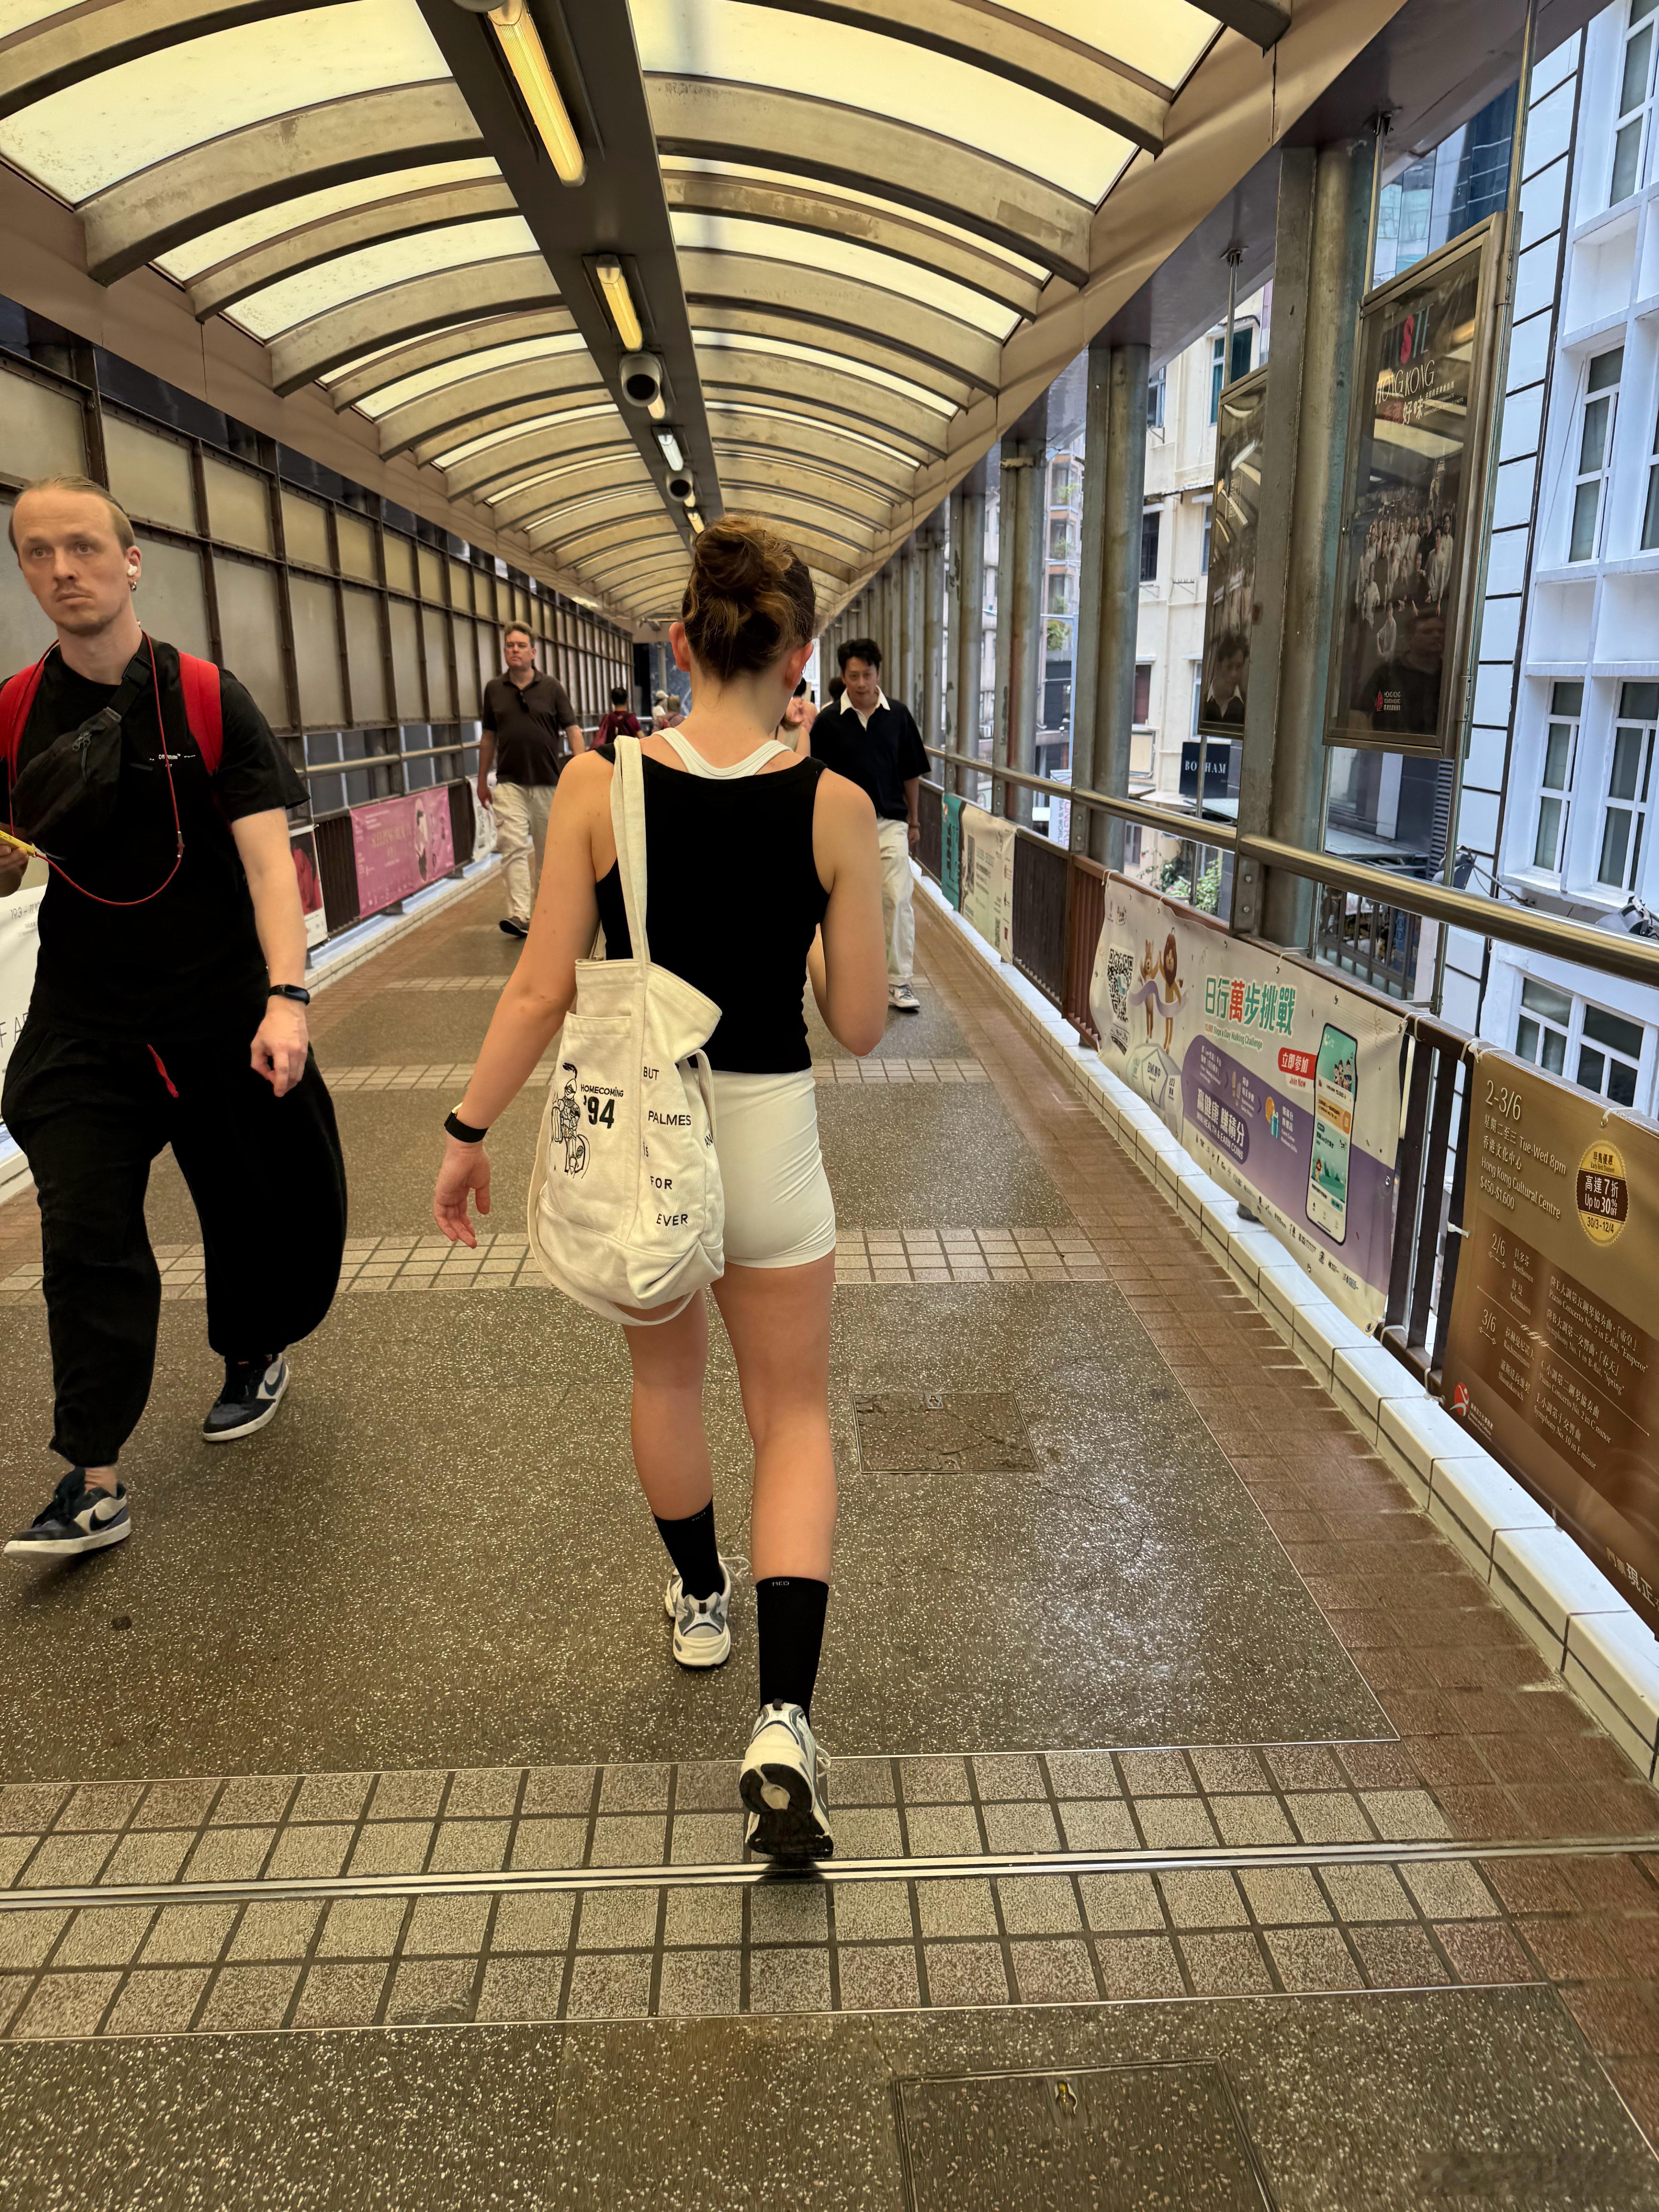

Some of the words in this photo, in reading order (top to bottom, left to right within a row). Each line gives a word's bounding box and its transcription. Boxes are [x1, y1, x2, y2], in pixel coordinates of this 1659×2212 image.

[1375, 369, 1403, 405] HONG
[1405, 360, 1434, 397] KONG
[1185, 760, 1226, 774] BOHAM
[1205, 977, 1296, 1036] 日行萬步挑戰
[1213, 1026, 1221, 1037] Steps
[1231, 1032, 1245, 1045] Walking
[1245, 1035, 1262, 1050] Challenge
[643, 1066, 659, 1080] BUT
[1281, 1052, 1309, 1073] 立即參加
[1297, 1078, 1306, 1088] Now
[1486, 1080, 1522, 1120] 2-3/6
[648, 1110, 691, 1126] PALMES
[1203, 1117, 1218, 1136] HEALTH
[1220, 1132, 1231, 1149] EARN
[1231, 1142, 1243, 1159] COINS
[1484, 1113, 1516, 1144] 星期二至三
[1520, 1135, 1549, 1164] Tue-Wed
[1550, 1154, 1566, 1175] 8pm
[1483, 1135, 1522, 1170] 香港文化中心
[650, 1176, 672, 1190] FOR
[1481, 1155, 1496, 1178] Hong
[1497, 1166, 1511, 1189] Kong
[1513, 1176, 1537, 1204] Cultural
[1539, 1194, 1561, 1219] Centre
[1585, 1193, 1593, 1210] Up
[1594, 1197, 1600, 1209] to
[656, 1213, 688, 1226] EVER
[1492, 1233, 1505, 1256] 2/6
[1482, 1309, 1496, 1332] 3/6
[1549, 1289, 1562, 1306] Piano
[1563, 1301, 1583, 1323] Concerto
[1585, 1317, 1593, 1331] No.
[1594, 1325, 1598, 1334] 5
[1599, 1330, 1604, 1340] in
[1569, 1341, 1577, 1355] No.
[1578, 1350, 1581, 1358] 1
[1582, 1355, 1587, 1363] in
[1551, 1384, 1571, 1408] Concerto
[1572, 1402, 1580, 1416] No.
[1580, 1410, 1585, 1420] 2
[1585, 1416, 1590, 1425] in
[1590, 1420, 1595, 1429] C
[1595, 1426, 1611, 1444] minor
[1534, 1405, 1556, 1433] Symphony
[1565, 1435, 1571, 1446] 10
[1571, 1443, 1576, 1452] in
[1577, 1445, 1581, 1455] E
[1581, 1451, 1596, 1470] minor
